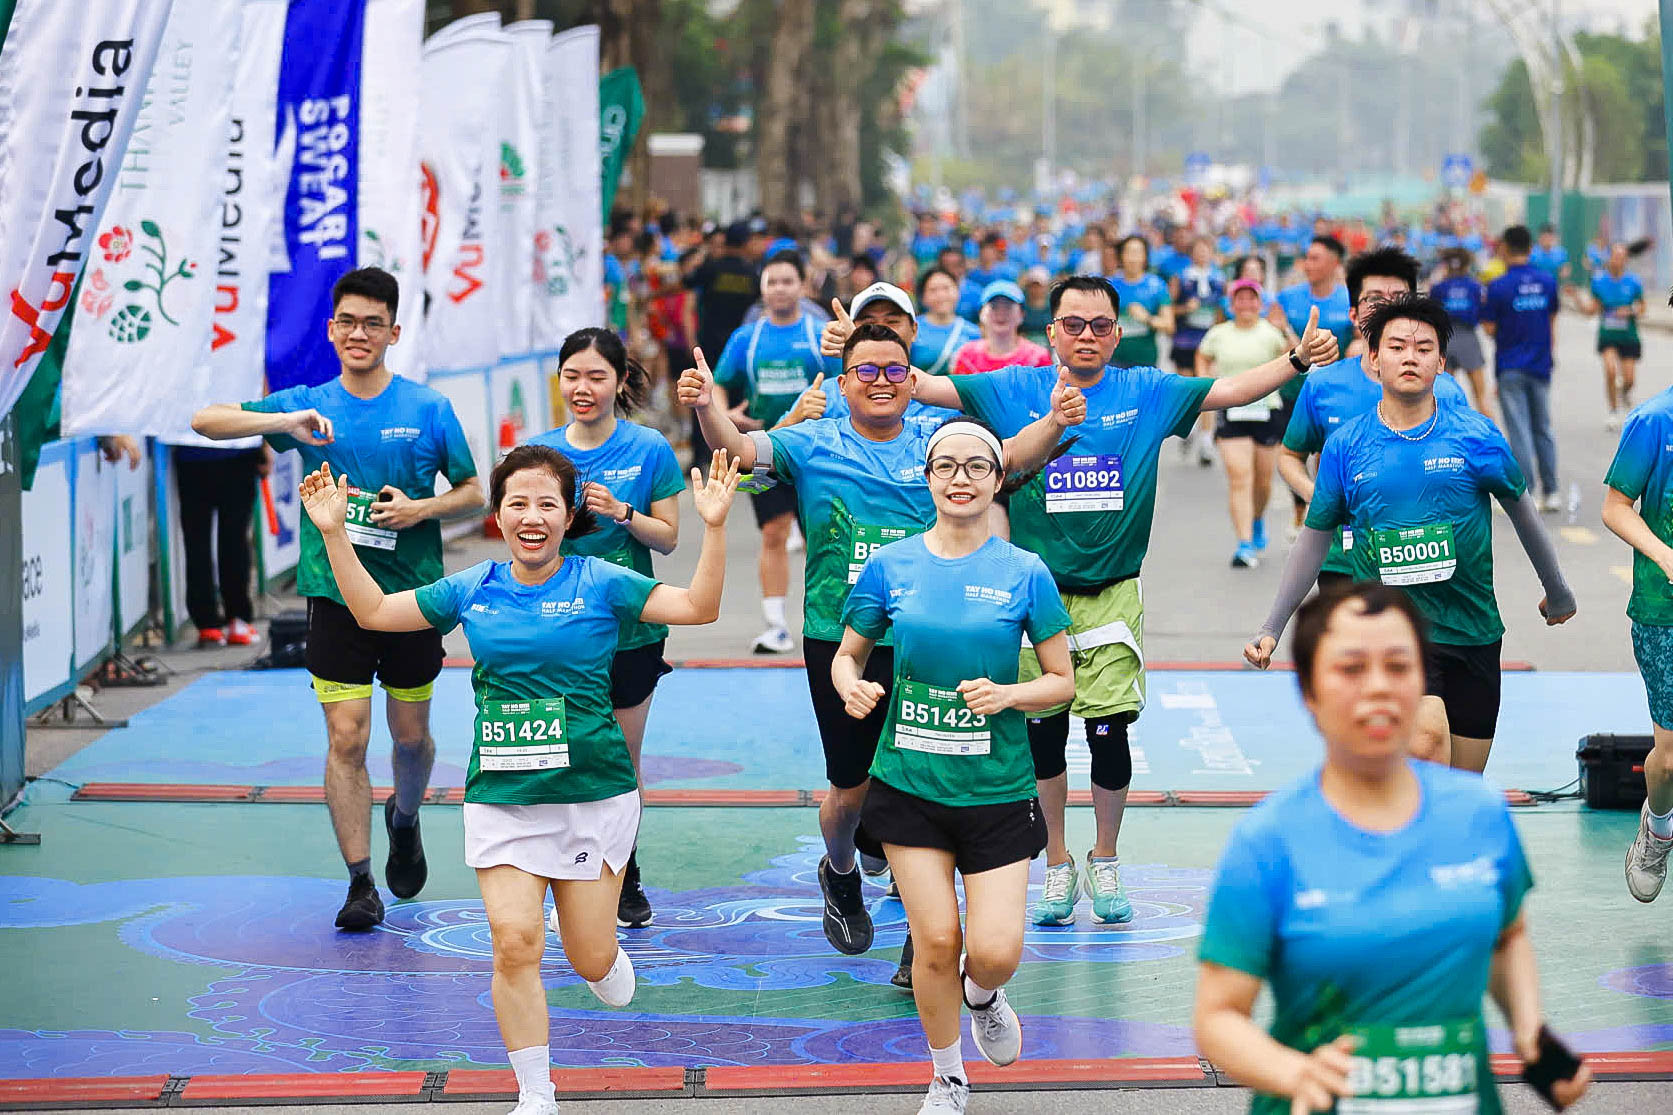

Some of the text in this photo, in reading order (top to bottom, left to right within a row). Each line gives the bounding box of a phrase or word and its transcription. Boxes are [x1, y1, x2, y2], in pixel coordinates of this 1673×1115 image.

[1048, 470, 1121, 489] C10892
[1380, 539, 1450, 564] B50001
[902, 699, 986, 728] B51423
[482, 718, 563, 742] B51424
